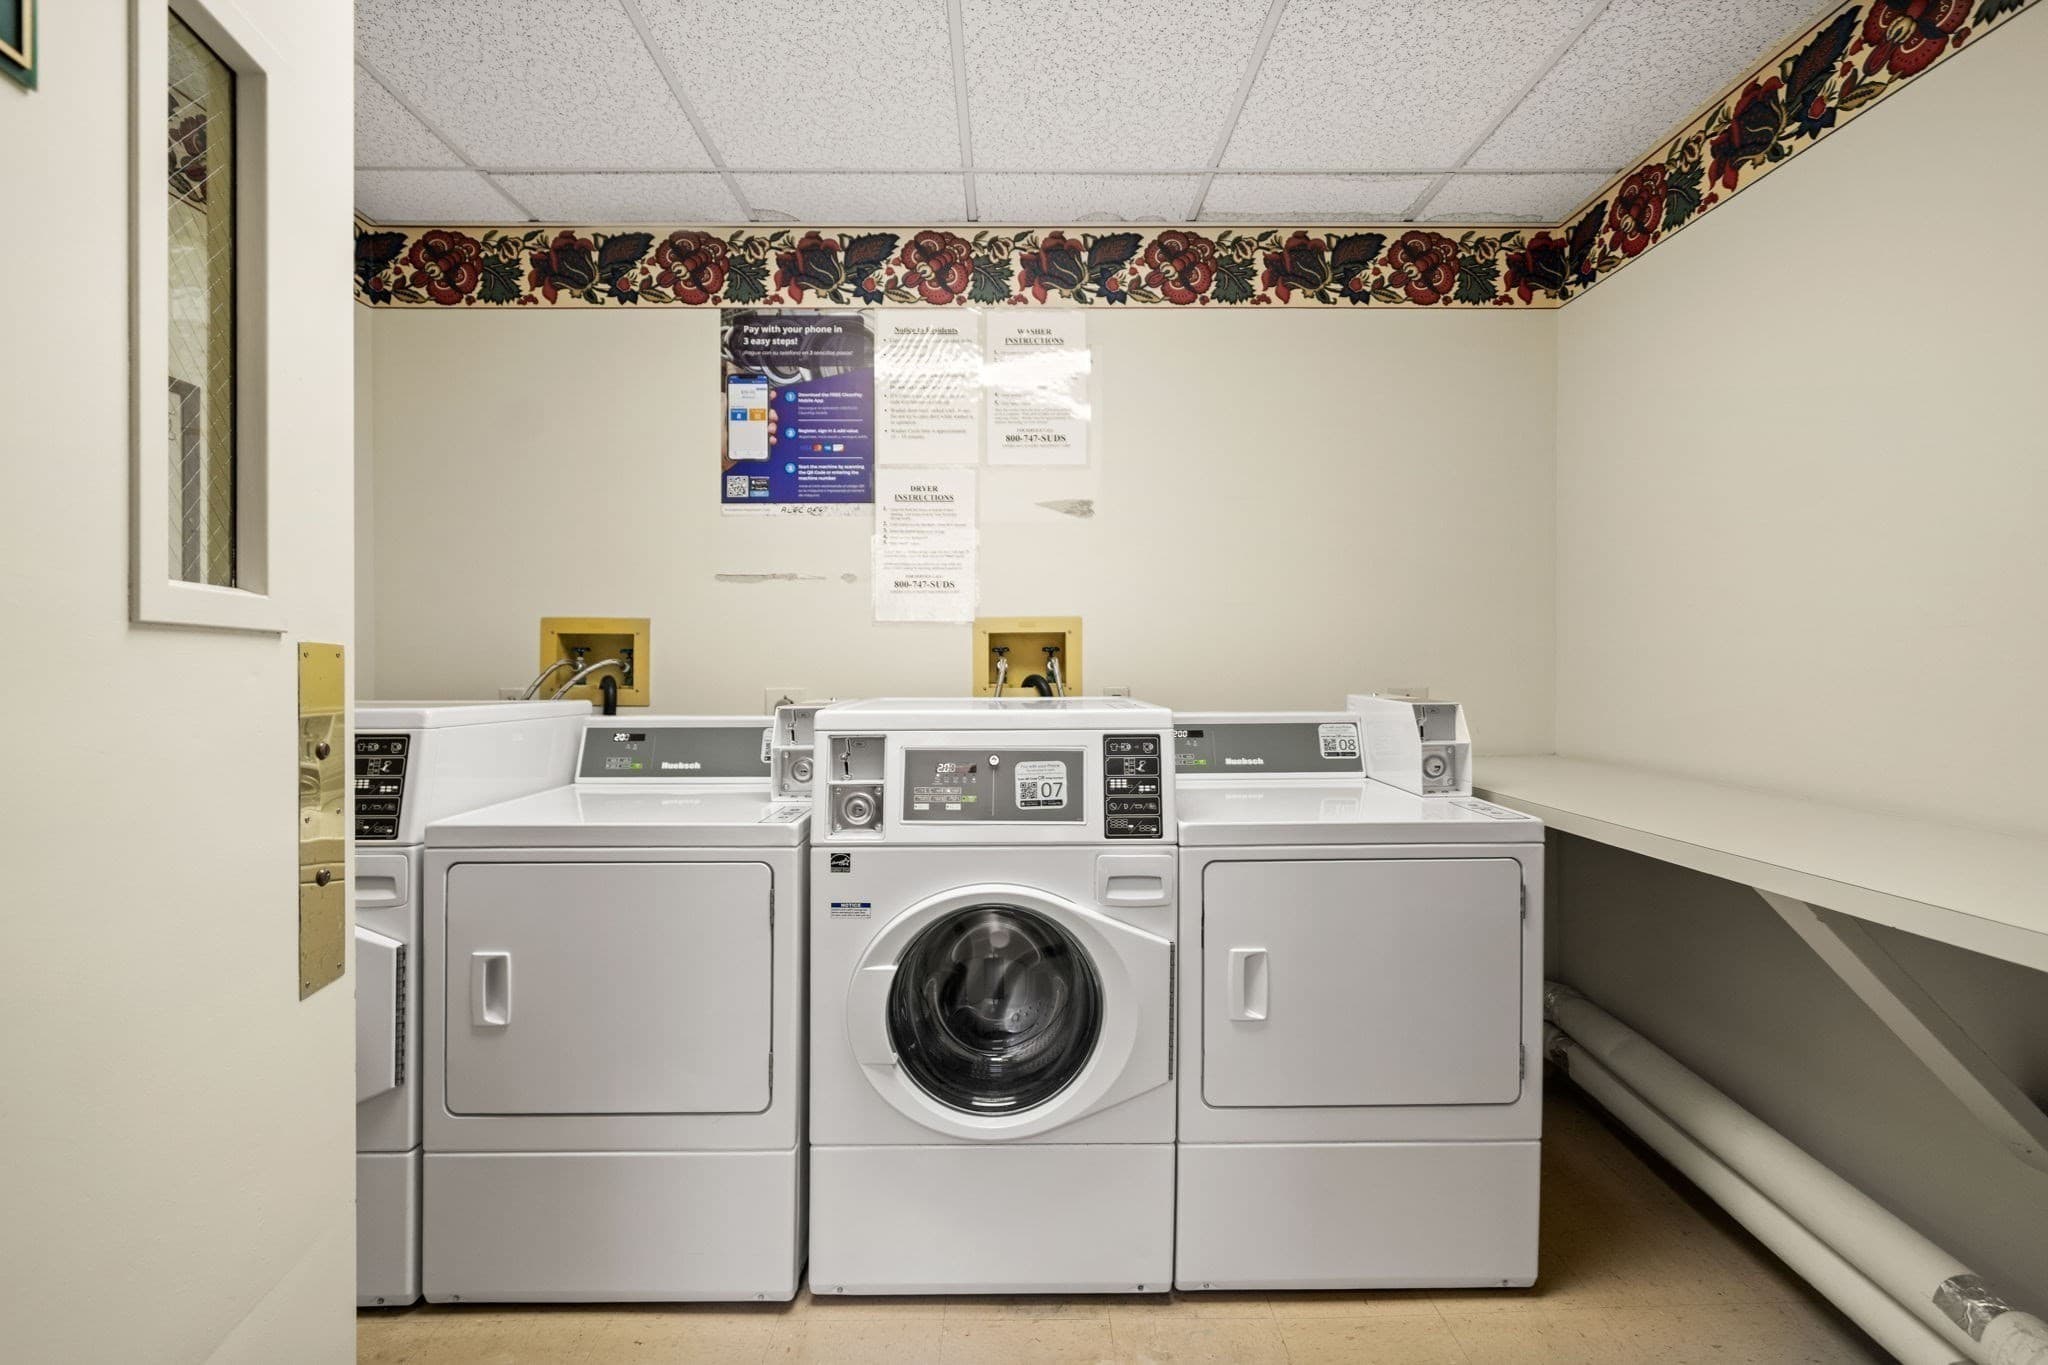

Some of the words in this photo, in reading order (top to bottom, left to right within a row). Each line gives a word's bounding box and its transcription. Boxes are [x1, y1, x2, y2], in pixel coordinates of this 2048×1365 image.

[743, 325, 759, 335] Pay
[761, 324, 781, 334] with
[782, 326, 802, 335] your
[804, 324, 832, 334] phone
[834, 325, 843, 334] in
[925, 326, 959, 335] Rsidents
[743, 337, 749, 345] 3
[750, 339, 771, 347] easy
[772, 337, 798, 347] steps!
[1005, 338, 1065, 346] INSTRUCTIONS
[1005, 434, 1067, 442] 800-747-SUDS
[894, 493, 955, 502] INSTRUCTIONS
[894, 580, 955, 588] 800-747-SUDS
[1338, 739, 1357, 751] 08
[661, 761, 701, 770] Huebsch
[1225, 757, 1264, 765] Huebsch
[1041, 782, 1063, 798] 07
